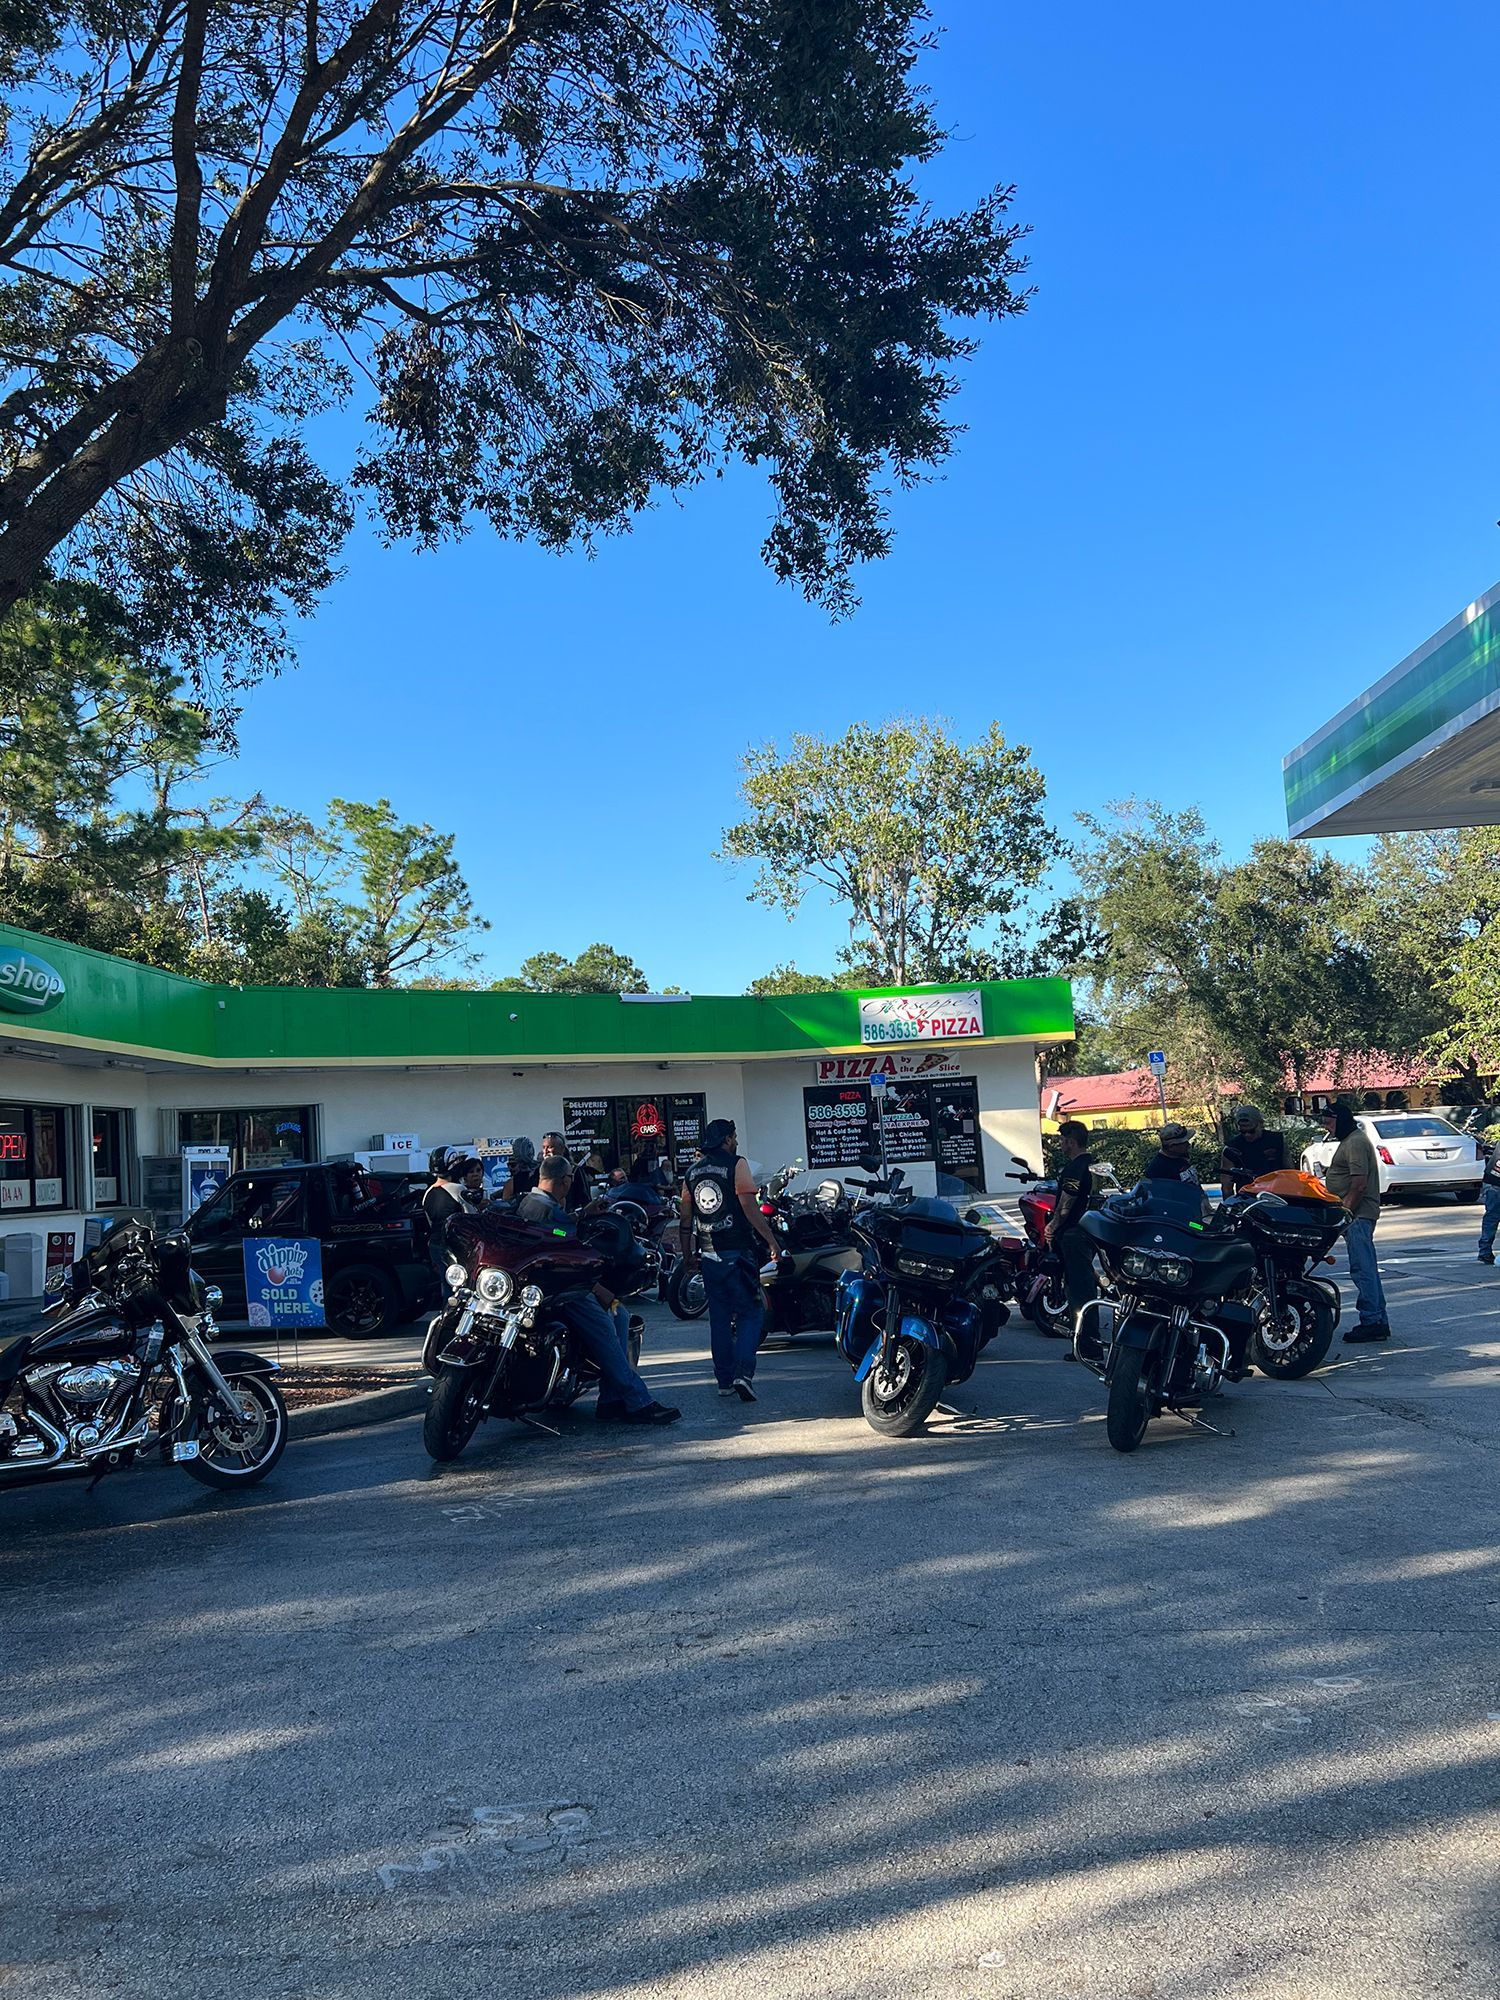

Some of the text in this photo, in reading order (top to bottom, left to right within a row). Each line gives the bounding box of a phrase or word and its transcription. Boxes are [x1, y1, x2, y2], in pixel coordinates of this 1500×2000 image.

[0, 957, 62, 1005] shop
[864, 1016, 981, 1041] 586-3535 PIZZA
[819, 1055, 912, 1079] PIZZA by
[938, 1063, 961, 1072] Slice
[840, 1092, 861, 1100] PIZZA
[569, 1101, 608, 1109] DELIVERIES
[809, 1103, 866, 1120] 586-3535
[640, 1124, 658, 1134] CRABS
[896, 1119, 930, 1128] EXPRESS
[0, 1135, 26, 1159] OPEN
[392, 1140, 412, 1150] ICE
[256, 1242, 308, 1273] dippin'
[285, 1266, 304, 1278] dots
[261, 1288, 298, 1300] SOLD
[274, 1302, 312, 1314] HERE
